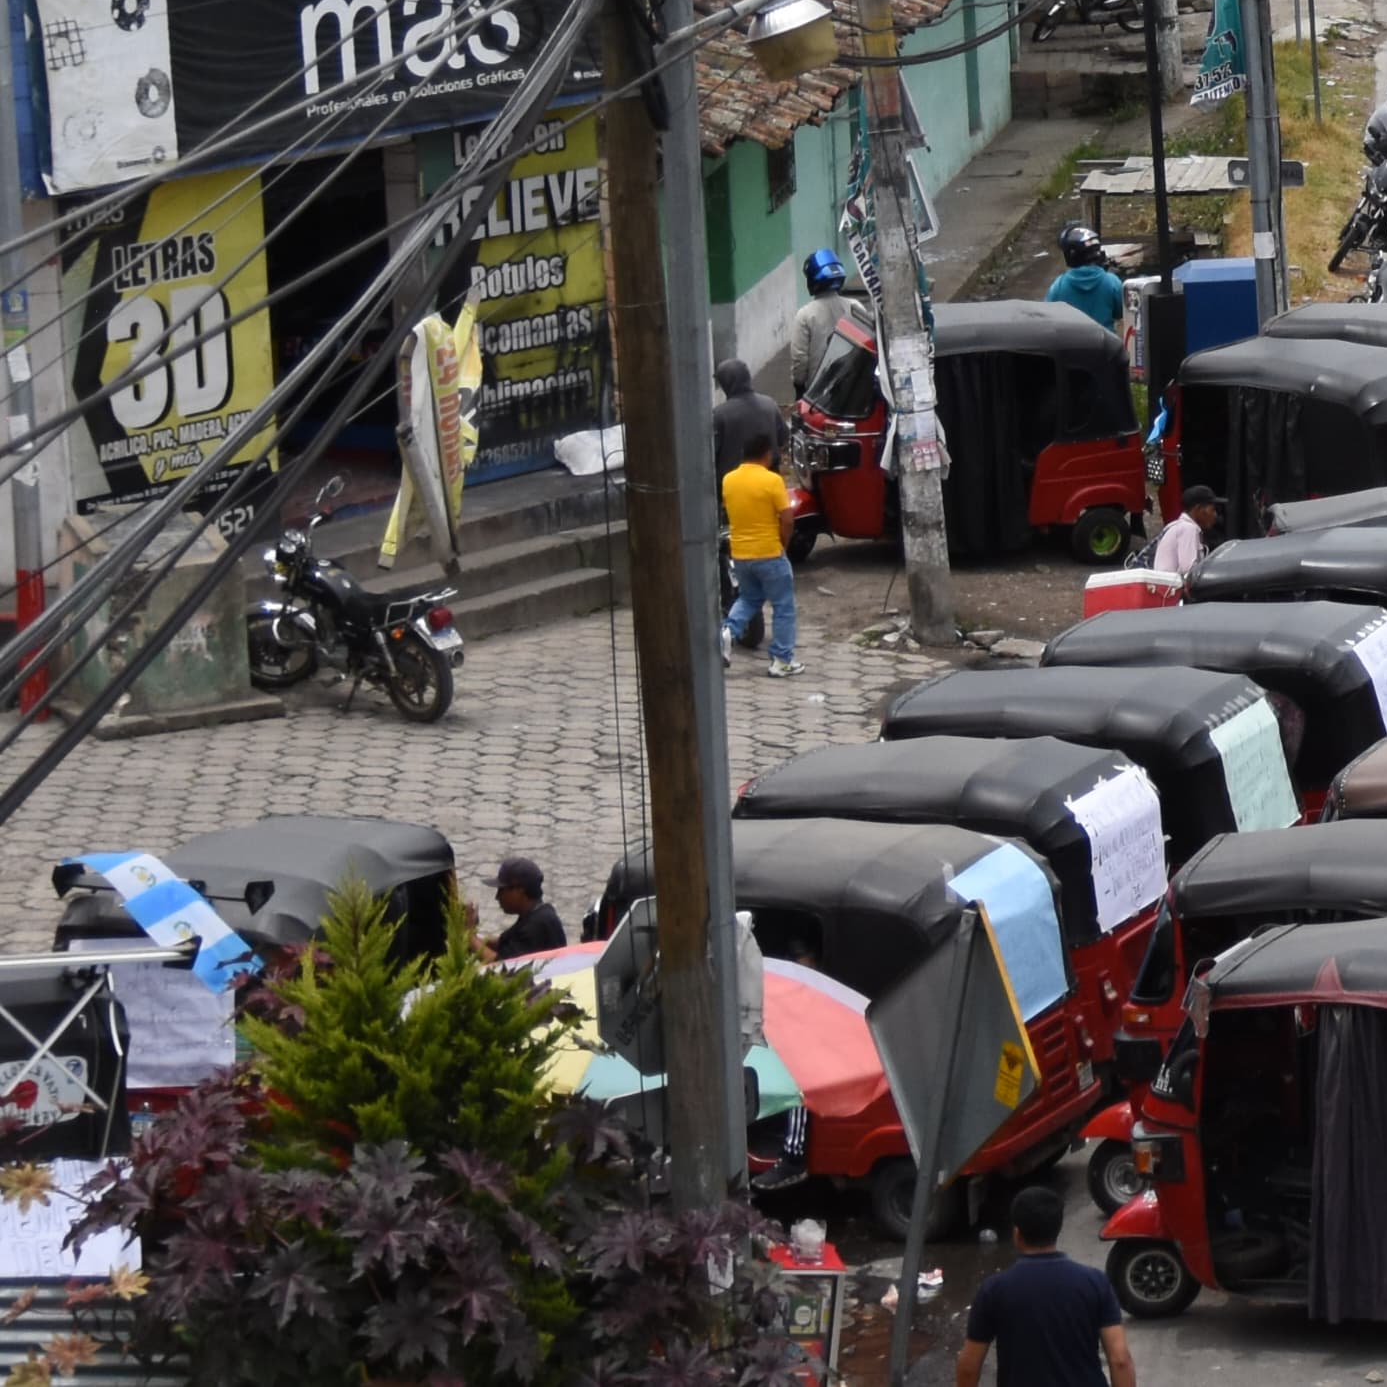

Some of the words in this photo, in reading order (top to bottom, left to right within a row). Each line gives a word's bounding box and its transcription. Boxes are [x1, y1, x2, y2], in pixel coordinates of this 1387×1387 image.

[392, 89, 407, 103] en
[476, 67, 526, 87] Gráficas
[112, 231, 217, 294] LETRAS
[105, 283, 234, 430] 3D
